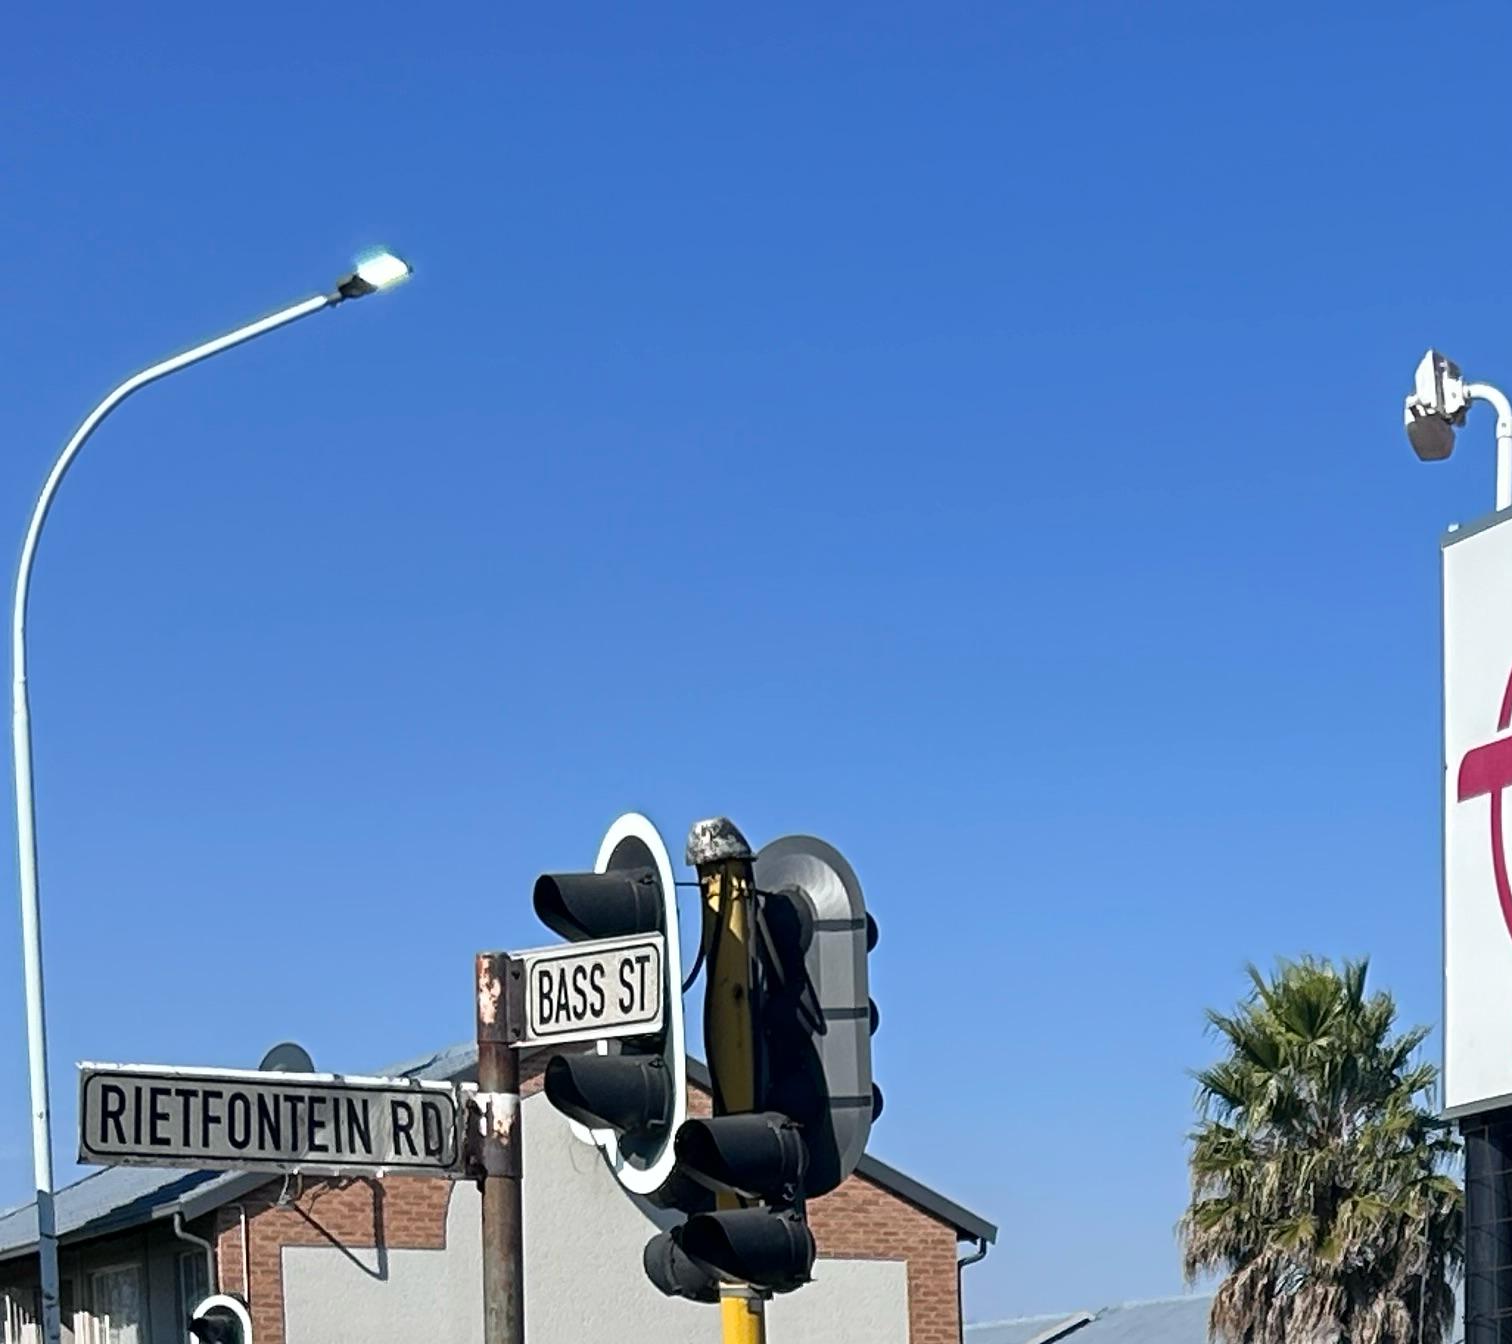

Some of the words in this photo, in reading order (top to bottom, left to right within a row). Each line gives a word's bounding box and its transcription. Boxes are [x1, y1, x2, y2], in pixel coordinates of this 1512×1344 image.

[538, 963, 605, 1025] BASS
[618, 954, 650, 1014] ST
[100, 1084, 372, 1155] RIETFONTEIN
[391, 1099, 444, 1157] RD
